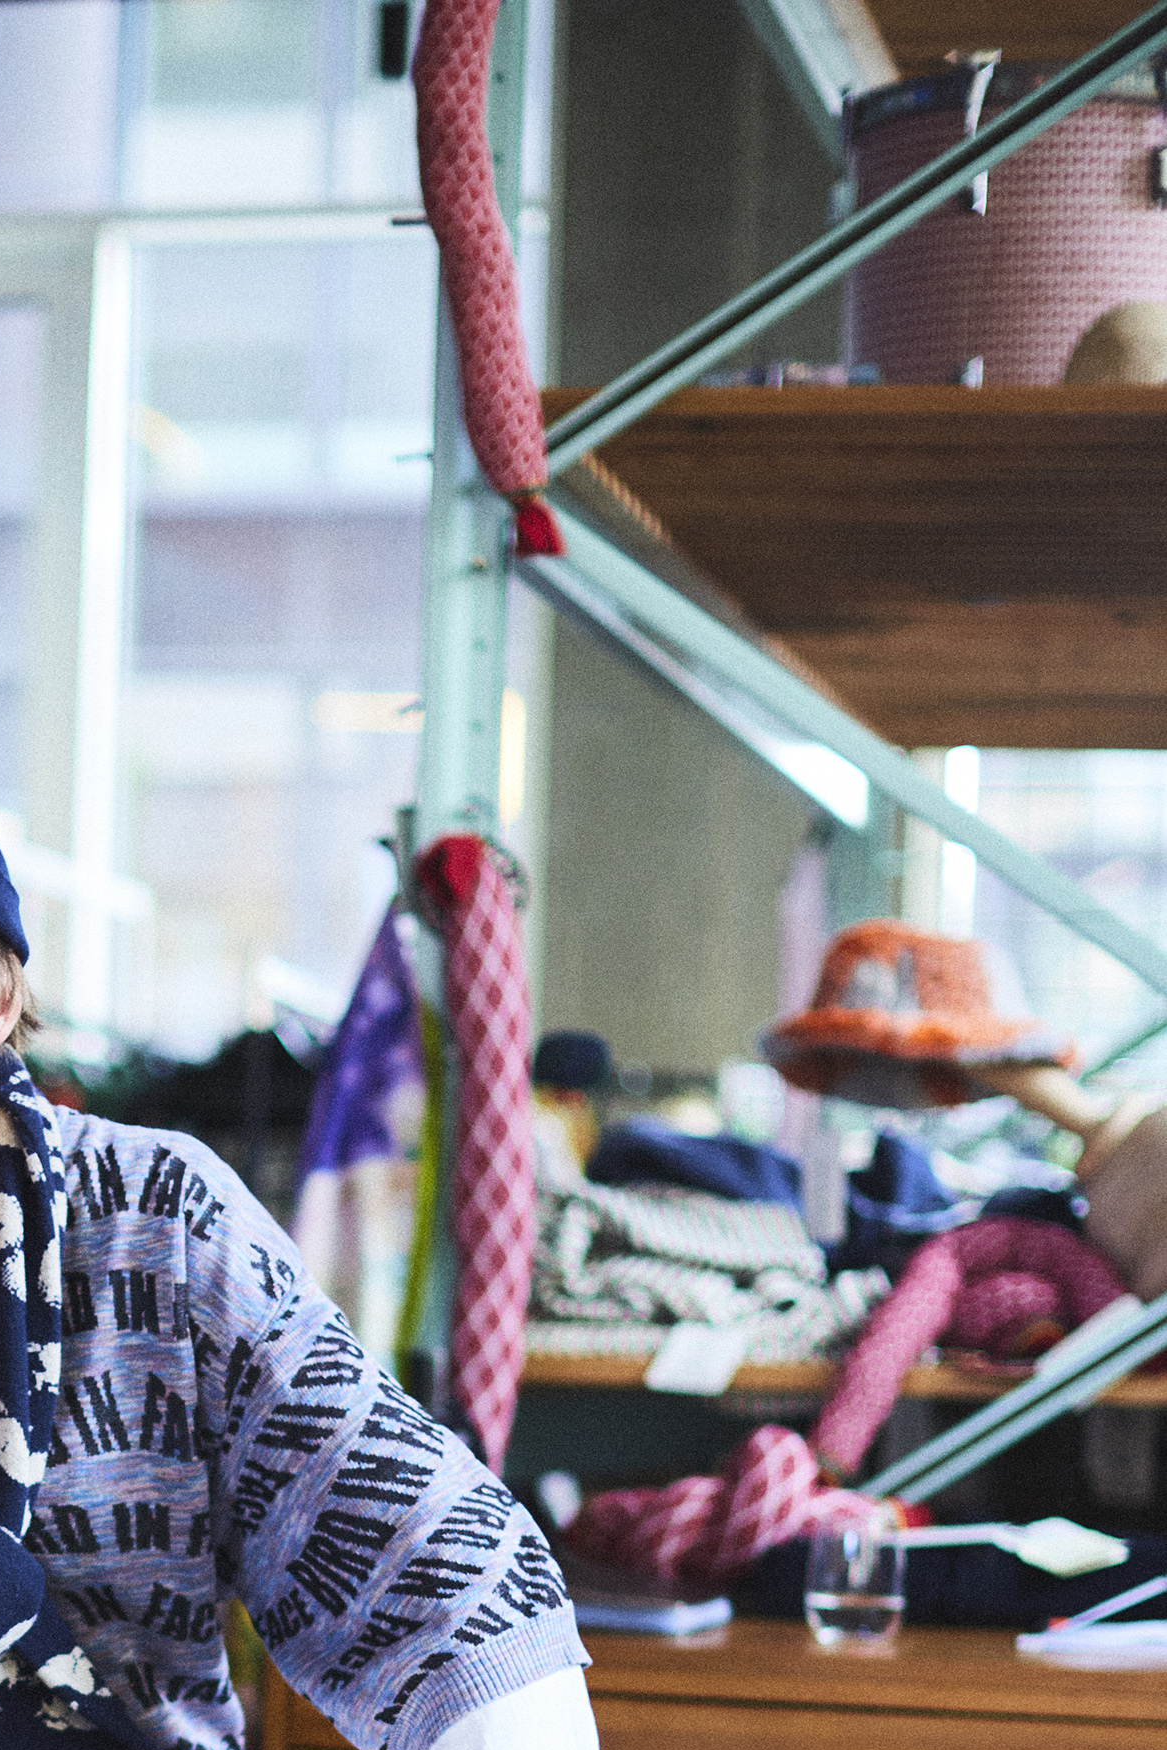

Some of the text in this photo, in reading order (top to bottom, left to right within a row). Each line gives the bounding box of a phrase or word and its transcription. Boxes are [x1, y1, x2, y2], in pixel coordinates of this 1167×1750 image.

[72, 1143, 225, 1243] IN FACE
[108, 1269, 160, 1334] IN
[63, 1370, 131, 1456] IN
[253, 1402, 350, 1454] IN
[330, 1449, 436, 1507] IN
[112, 1502, 172, 1553] IN
[426, 1483, 516, 1550] BIRD
[286, 1509, 398, 1617] BIRD
[385, 1552, 486, 1600] IN
[140, 1581, 221, 1644] FAC
[320, 1610, 427, 1692] FACE
